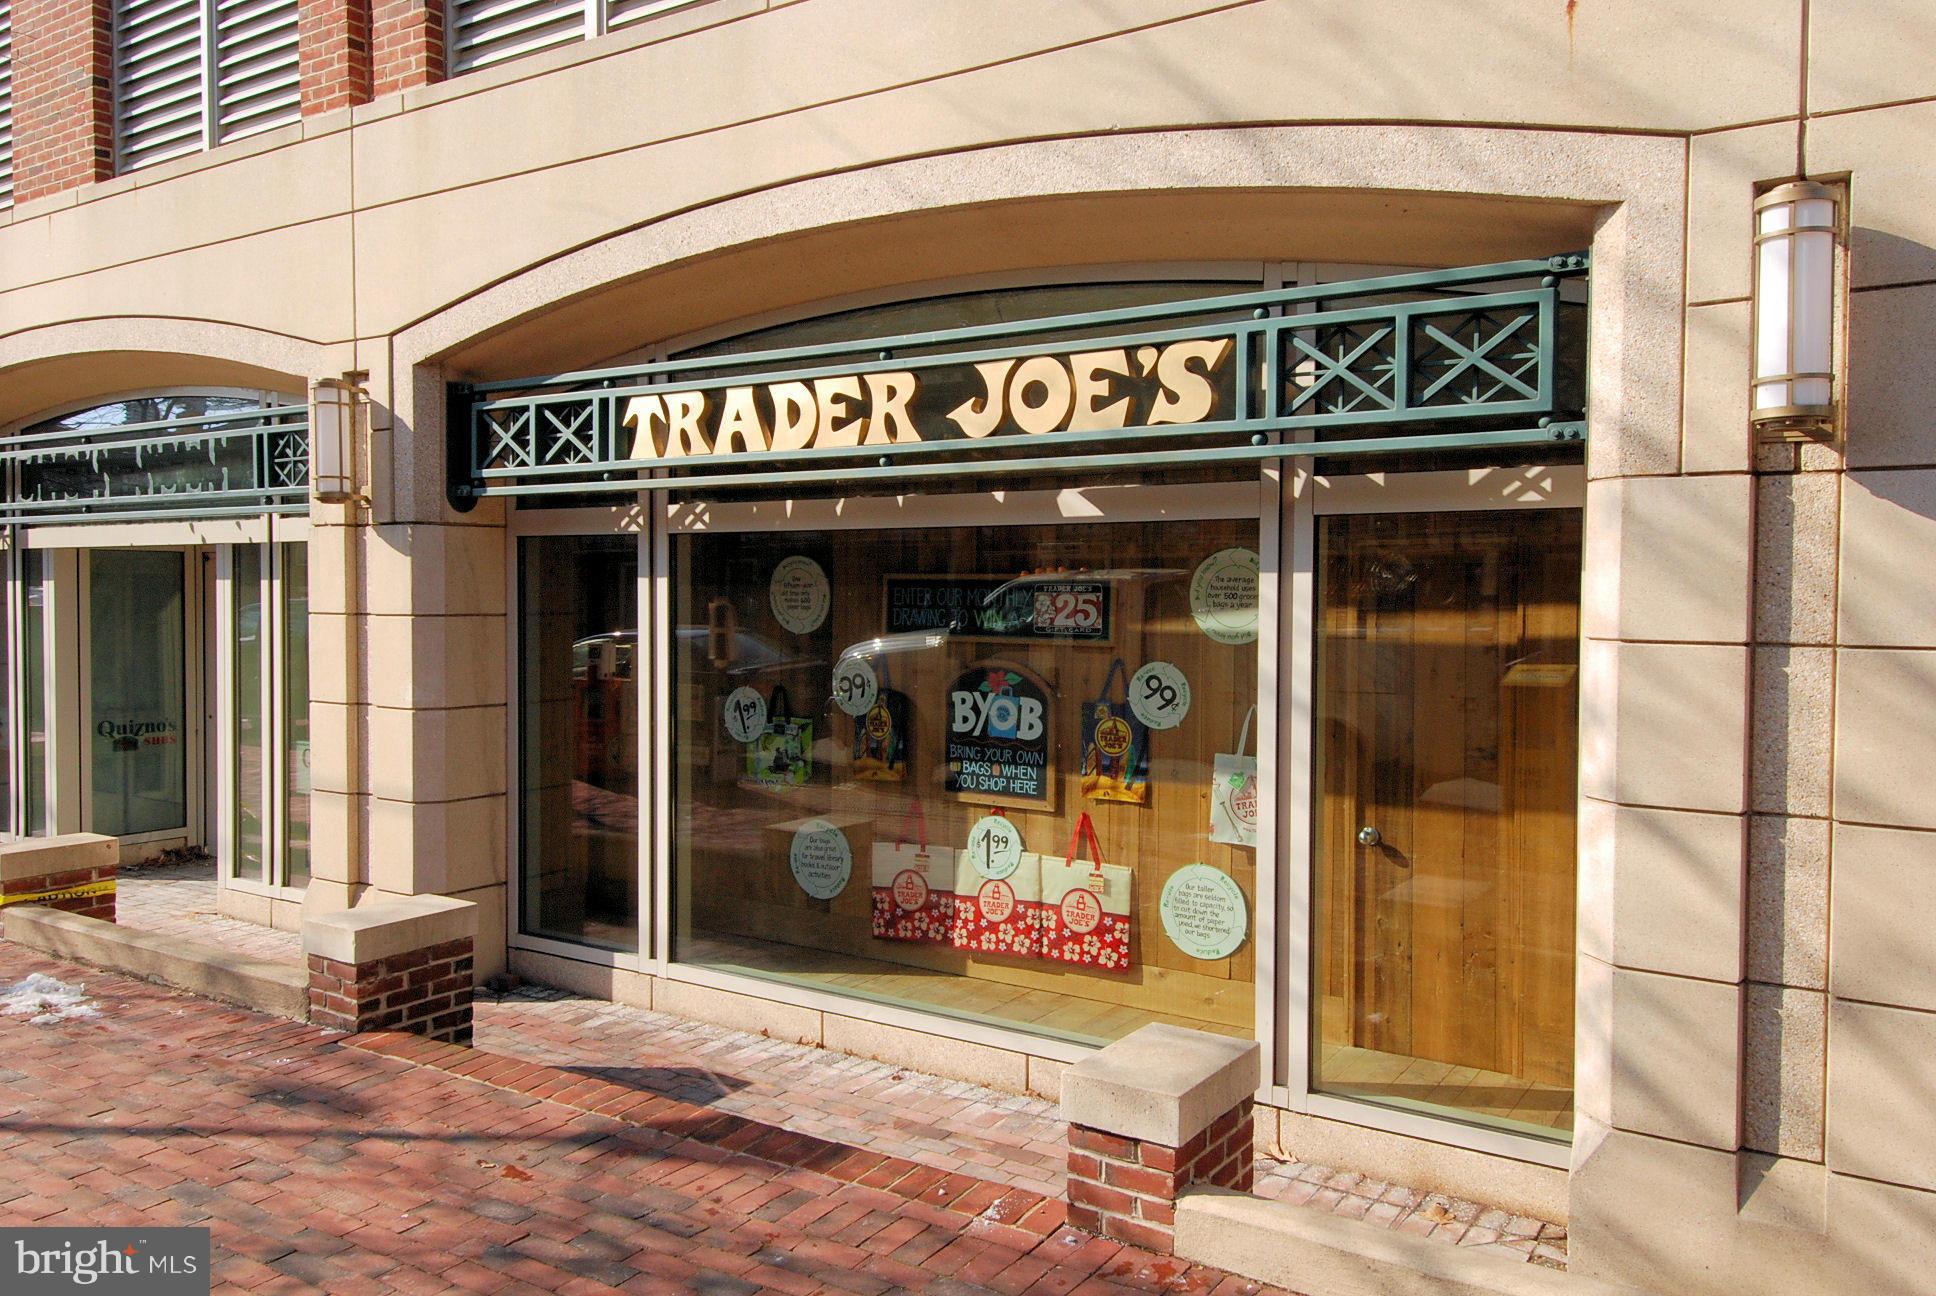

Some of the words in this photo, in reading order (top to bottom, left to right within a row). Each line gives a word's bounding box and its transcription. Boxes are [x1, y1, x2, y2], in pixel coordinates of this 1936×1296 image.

[623, 370, 922, 460] TRADER
[946, 338, 1235, 439] JOE'S
[1043, 585, 1071, 593] TRADER
[1073, 584, 1093, 592] JOE'S
[1224, 592, 1238, 600] 500
[951, 690, 1044, 741] BYOB
[950, 744, 981, 759] BRING
[985, 747, 1013, 762] YOUR
[1016, 751, 1044, 766] OWN
[962, 760, 991, 776] BAGS
[1002, 764, 1037, 780] WHEN
[956, 774, 976, 788] YOU
[979, 776, 1007, 791] SHOP
[1010, 779, 1038, 795] HERE
[1185, 883, 1195, 891] Our
[1197, 885, 1214, 893] taller
[1204, 894, 1226, 903] seldom
[983, 901, 1010, 909] TRADER
[985, 908, 1005, 916] JOE'S
[1065, 910, 1096, 920] TRADER
[1174, 912, 1196, 920] amount
[1192, 908, 1208, 916] down
[1068, 918, 1090, 928] JOE'S
